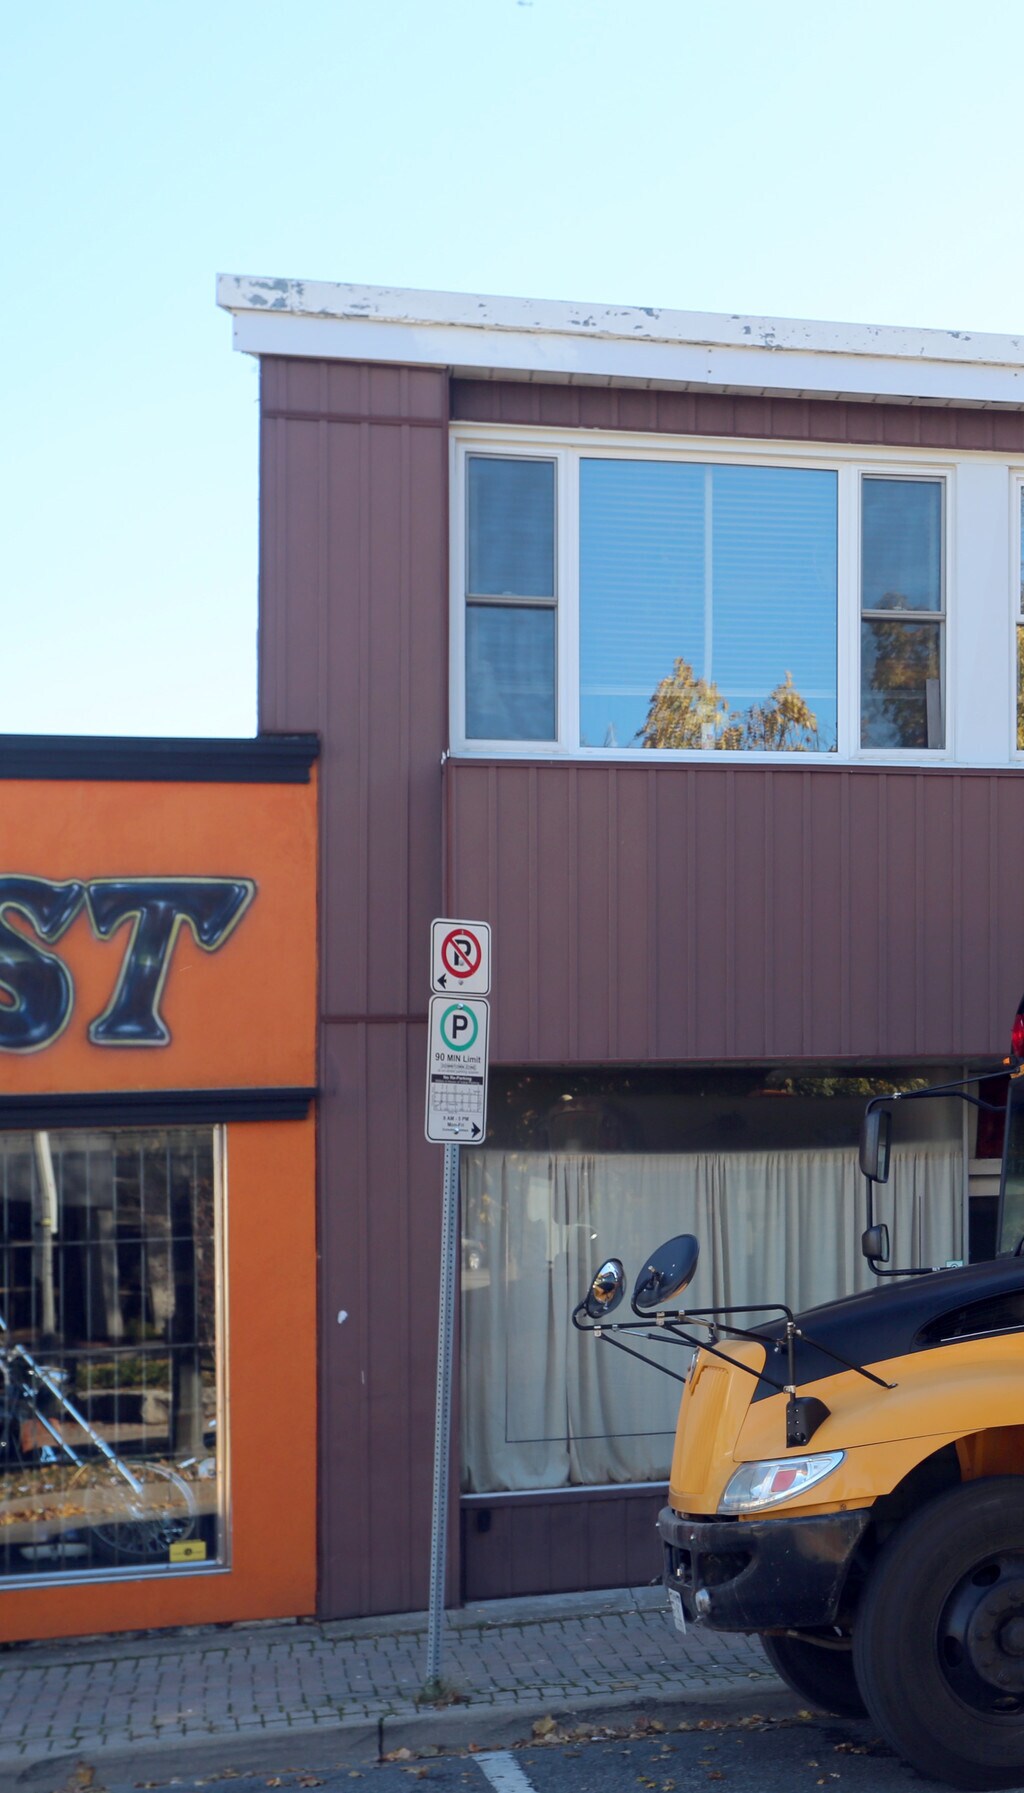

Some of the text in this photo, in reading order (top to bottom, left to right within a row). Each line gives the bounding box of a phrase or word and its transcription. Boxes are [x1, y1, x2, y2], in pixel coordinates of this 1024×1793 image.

[452, 1014, 468, 1039] P
[435, 1052, 481, 1063] 90 MIN Limit
